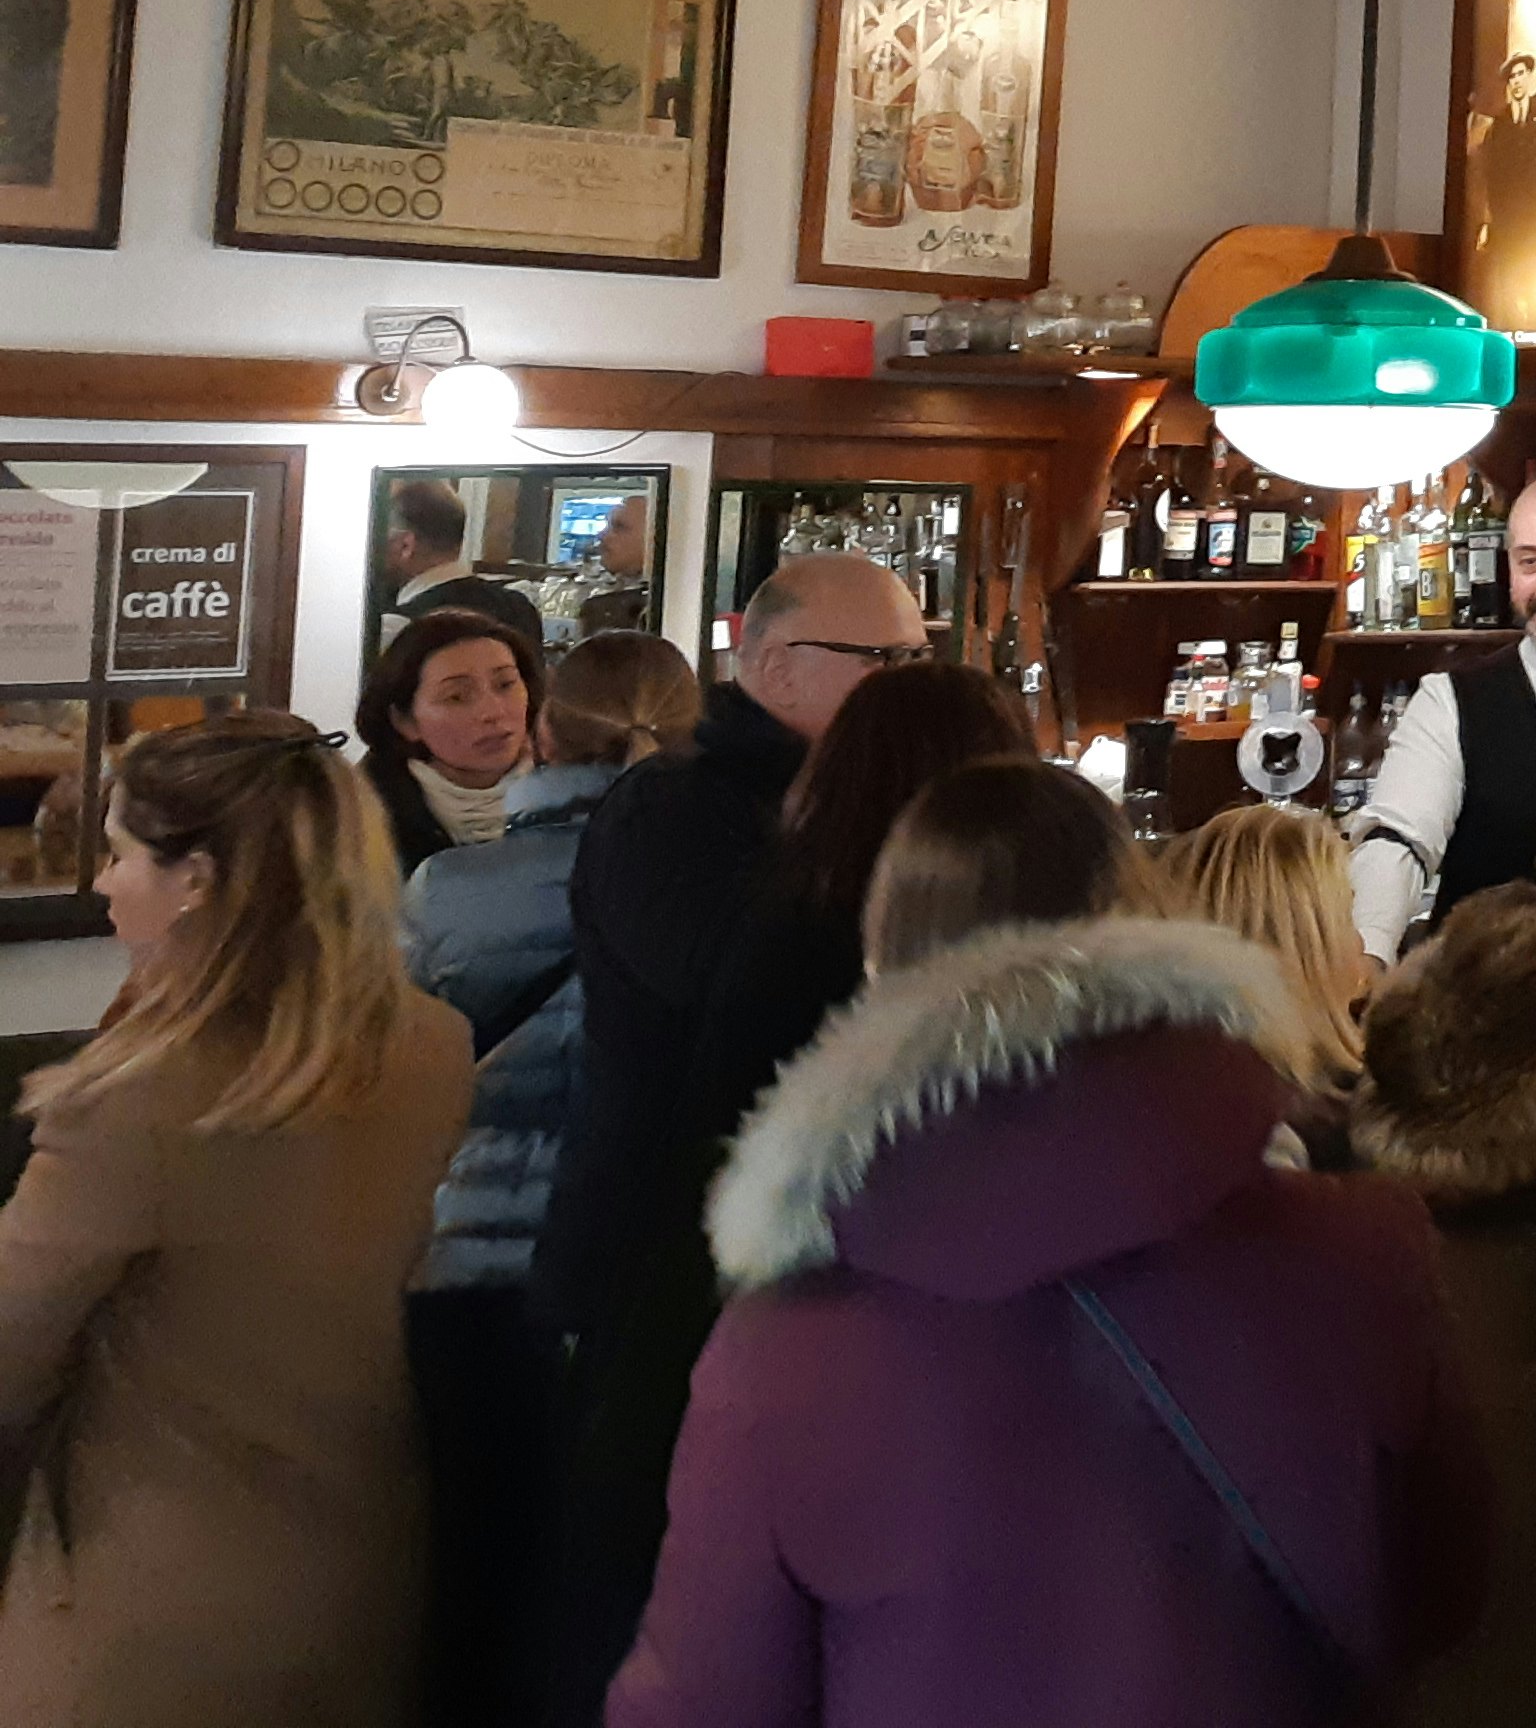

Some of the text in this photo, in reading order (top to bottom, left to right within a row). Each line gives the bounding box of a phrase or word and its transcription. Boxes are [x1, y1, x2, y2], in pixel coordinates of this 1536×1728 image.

[131, 542, 237, 563] crema di
[122, 580, 231, 619] caffè
